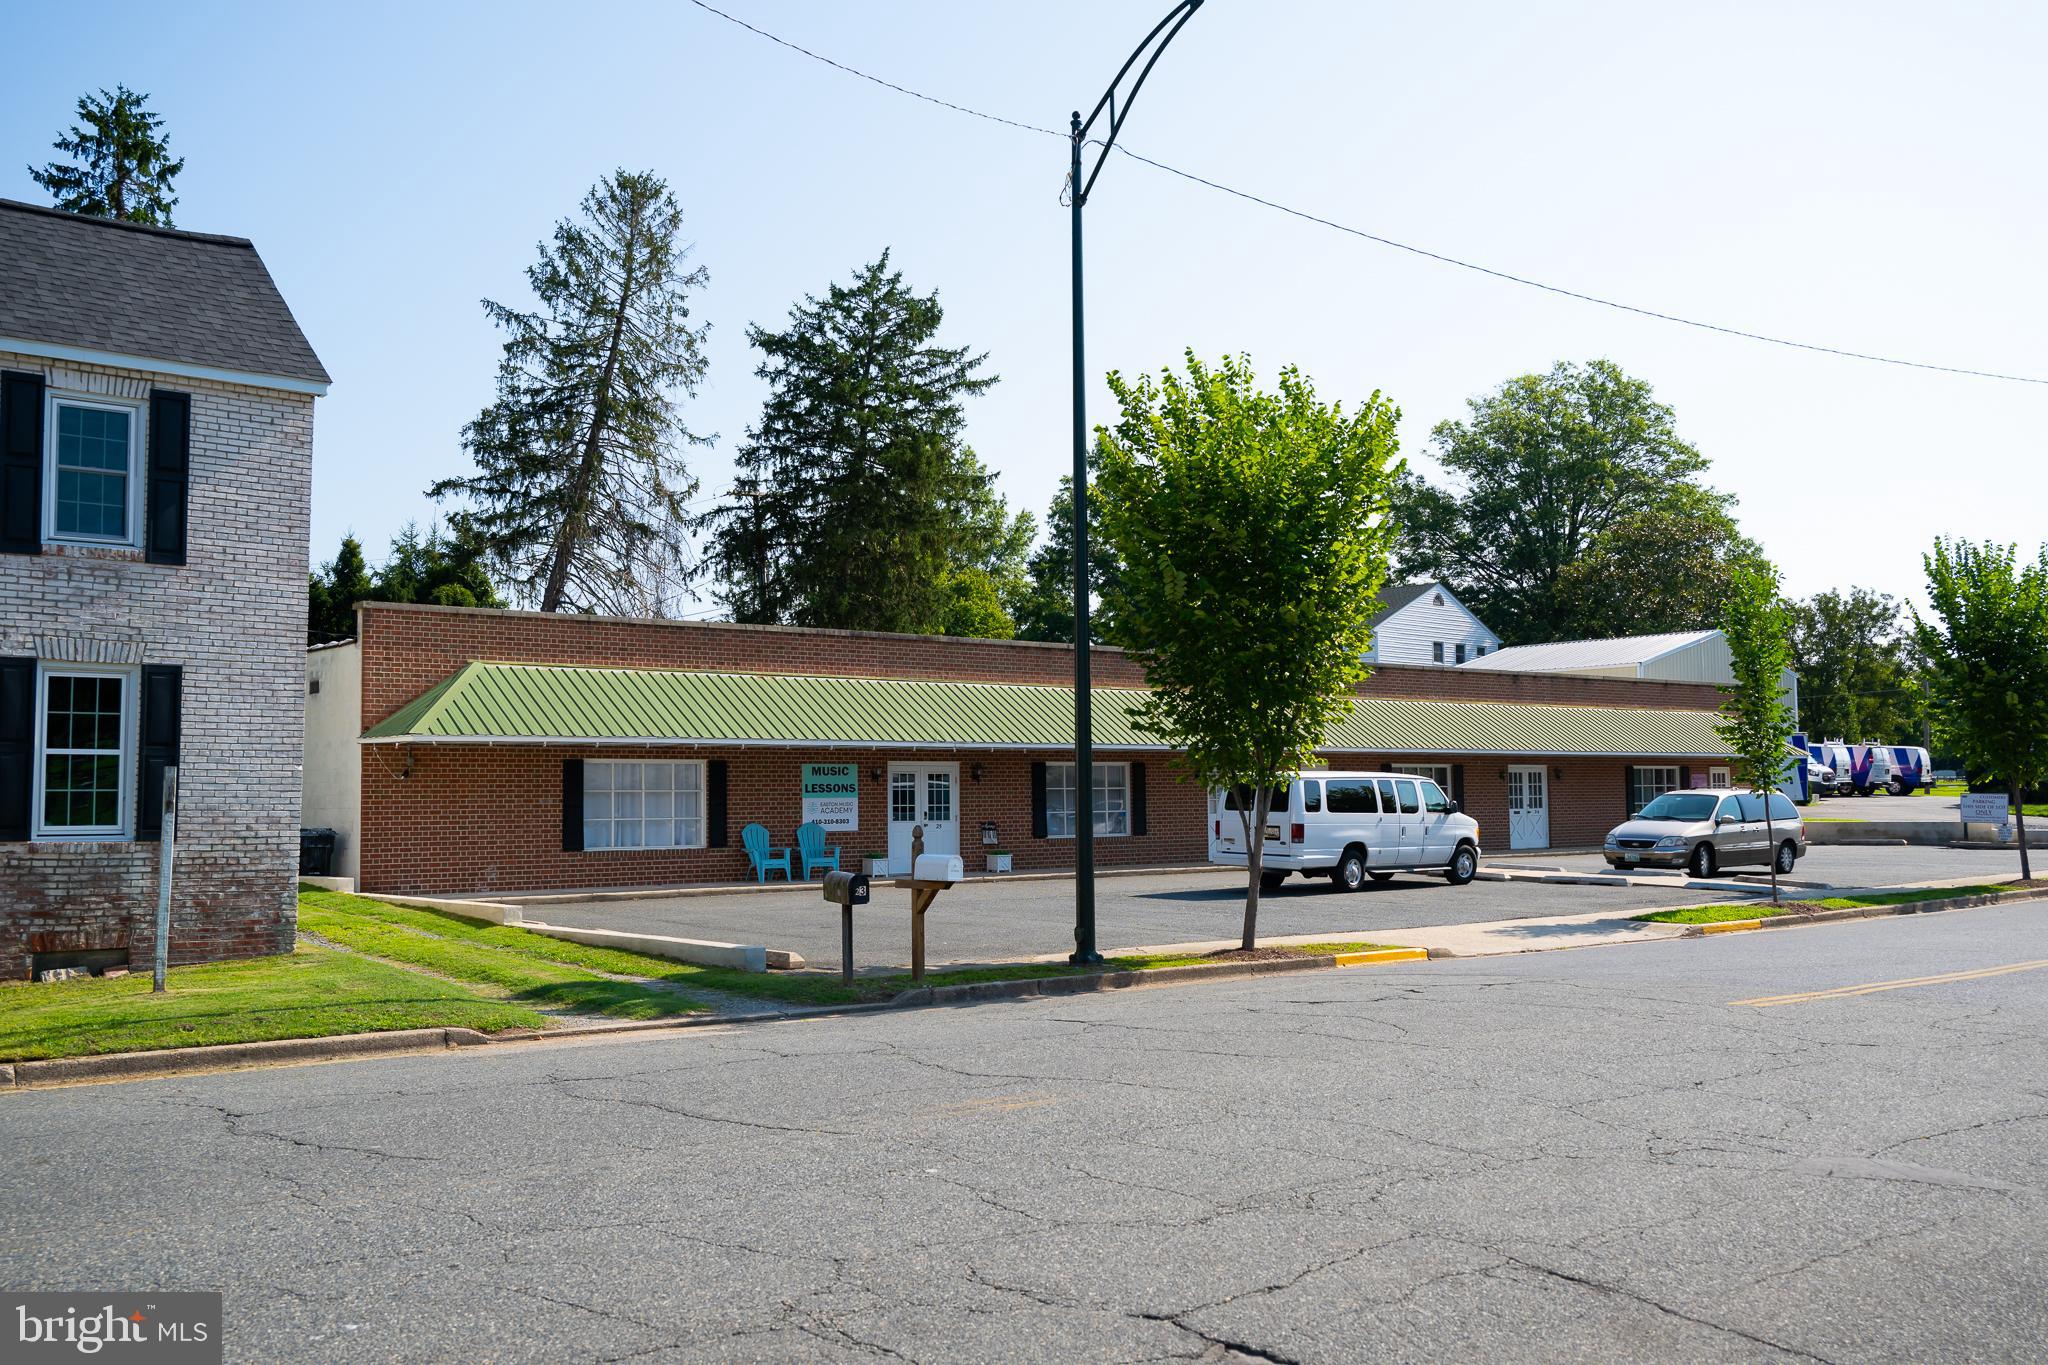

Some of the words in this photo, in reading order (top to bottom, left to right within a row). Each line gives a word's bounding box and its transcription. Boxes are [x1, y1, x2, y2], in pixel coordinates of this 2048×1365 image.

[811, 766, 849, 776] MUSIC
[804, 783, 856, 793] LESSONS
[820, 806, 853, 814] ACADEMY
[855, 886, 866, 896] 23
